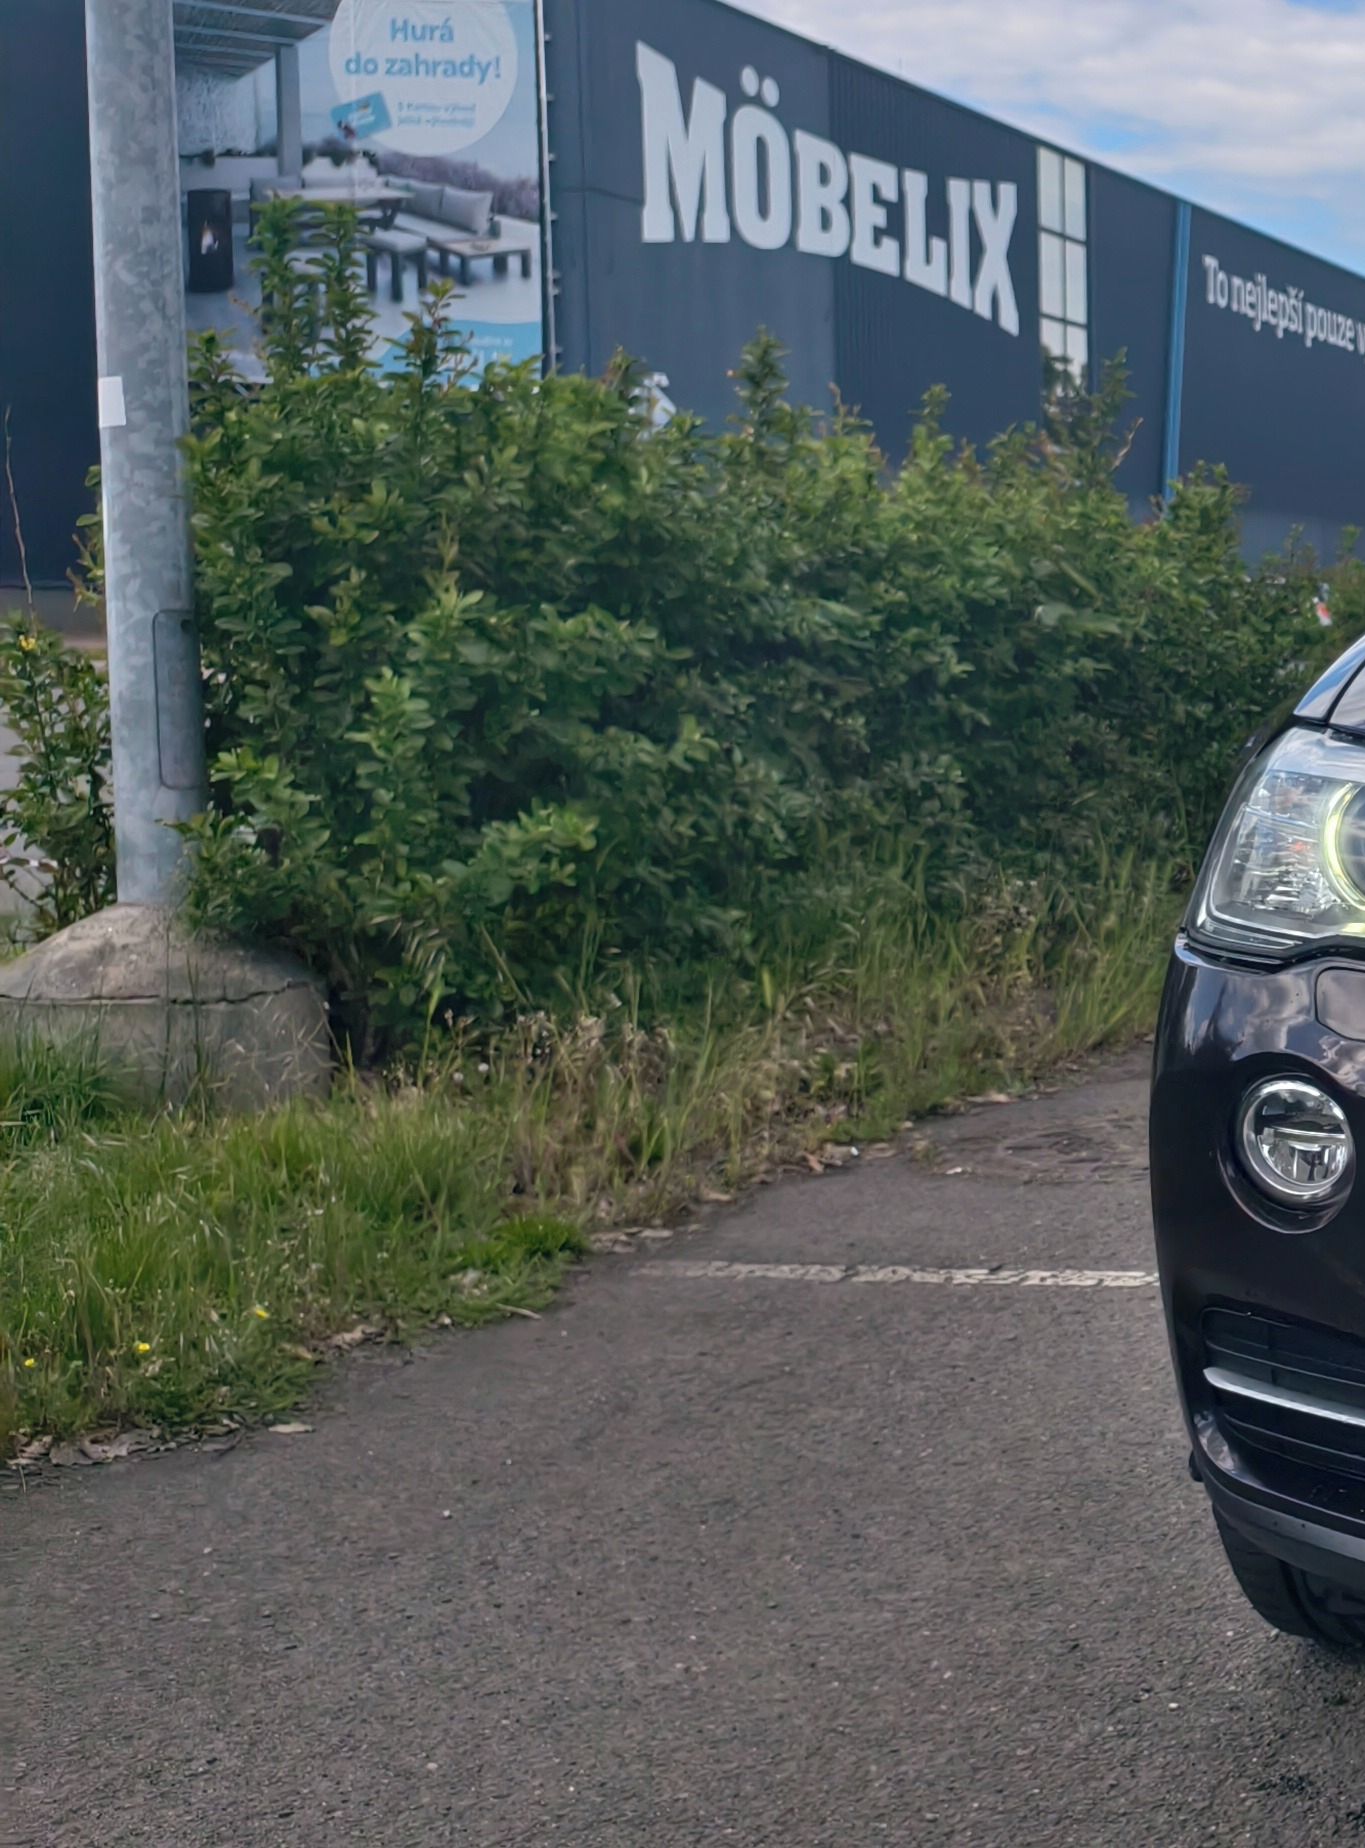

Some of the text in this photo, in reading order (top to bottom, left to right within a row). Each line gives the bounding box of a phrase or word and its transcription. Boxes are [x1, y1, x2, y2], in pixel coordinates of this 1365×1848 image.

[390, 17, 454, 43] Hurá
[345, 52, 501, 85] do zahrady!
[636, 40, 1019, 337] MÖBELIX
[1202, 254, 1229, 308] To
[1231, 272, 1304, 339] nejlepší
[1305, 302, 1355, 351] pouze
